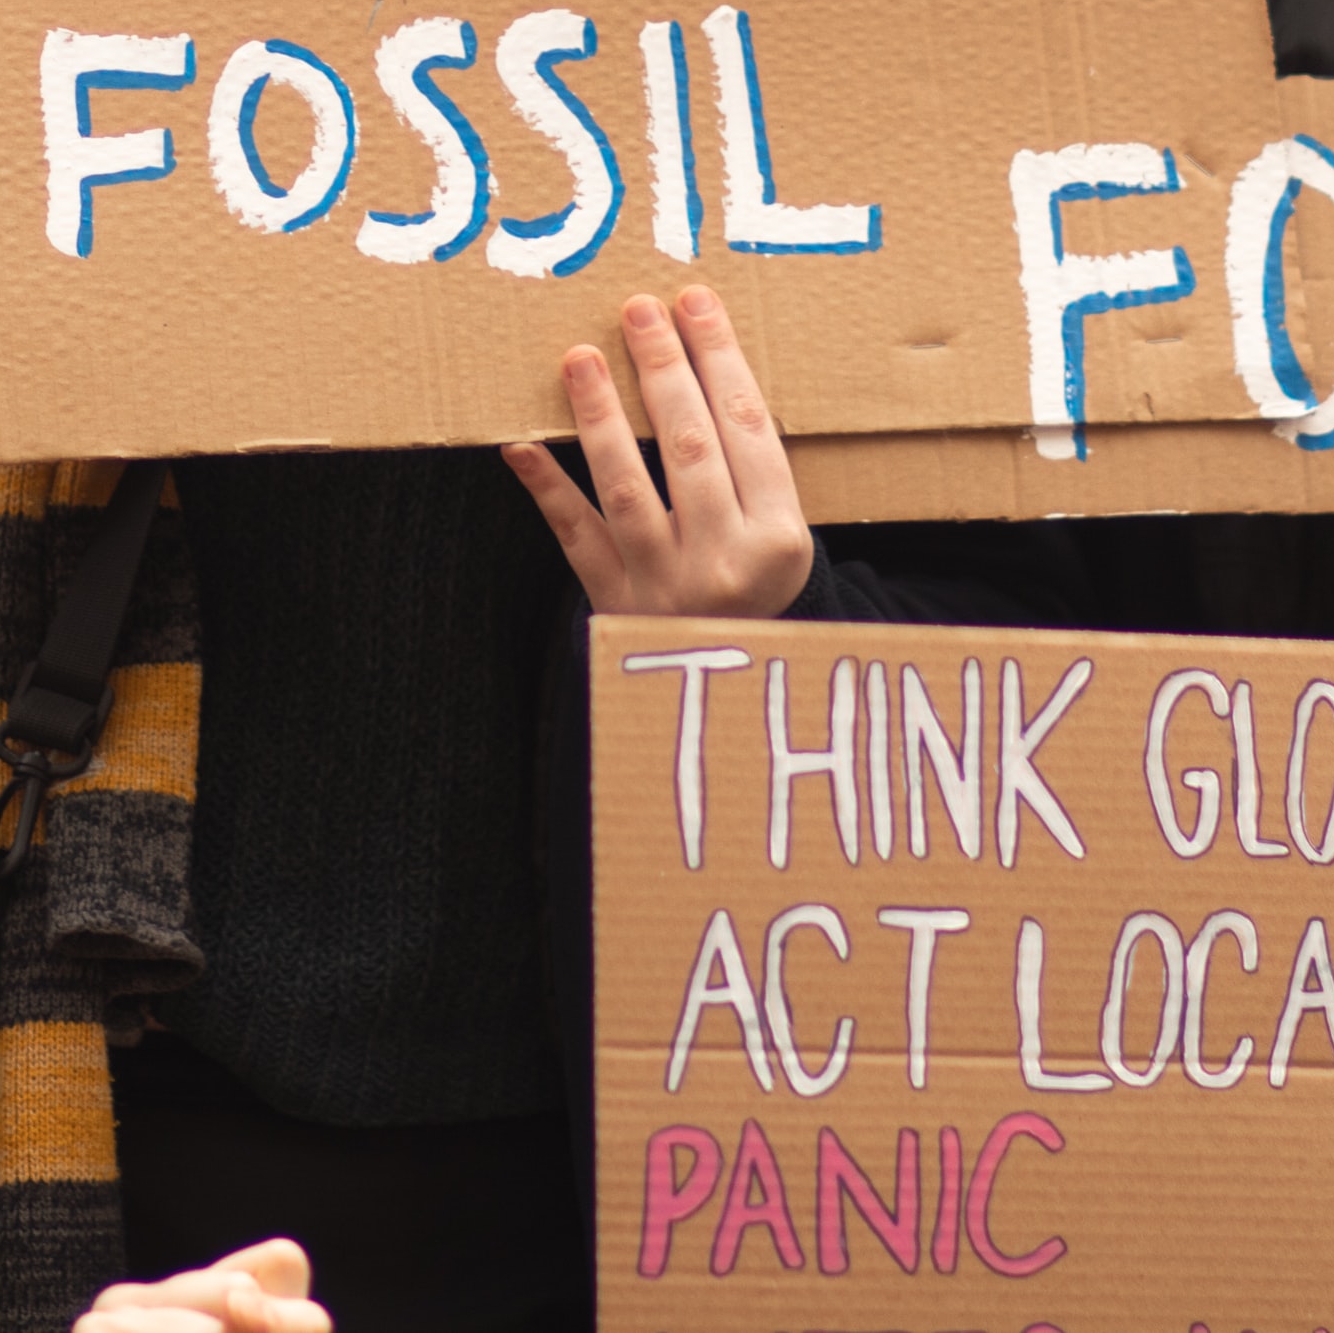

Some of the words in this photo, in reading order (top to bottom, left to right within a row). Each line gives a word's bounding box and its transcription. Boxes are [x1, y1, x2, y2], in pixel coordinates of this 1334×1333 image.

[41, 6, 882, 278] FOSSIL
[623, 647, 1094, 871] THINK
[666, 903, 971, 1098] ACT
[636, 1111, 1067, 1277] PANIC
